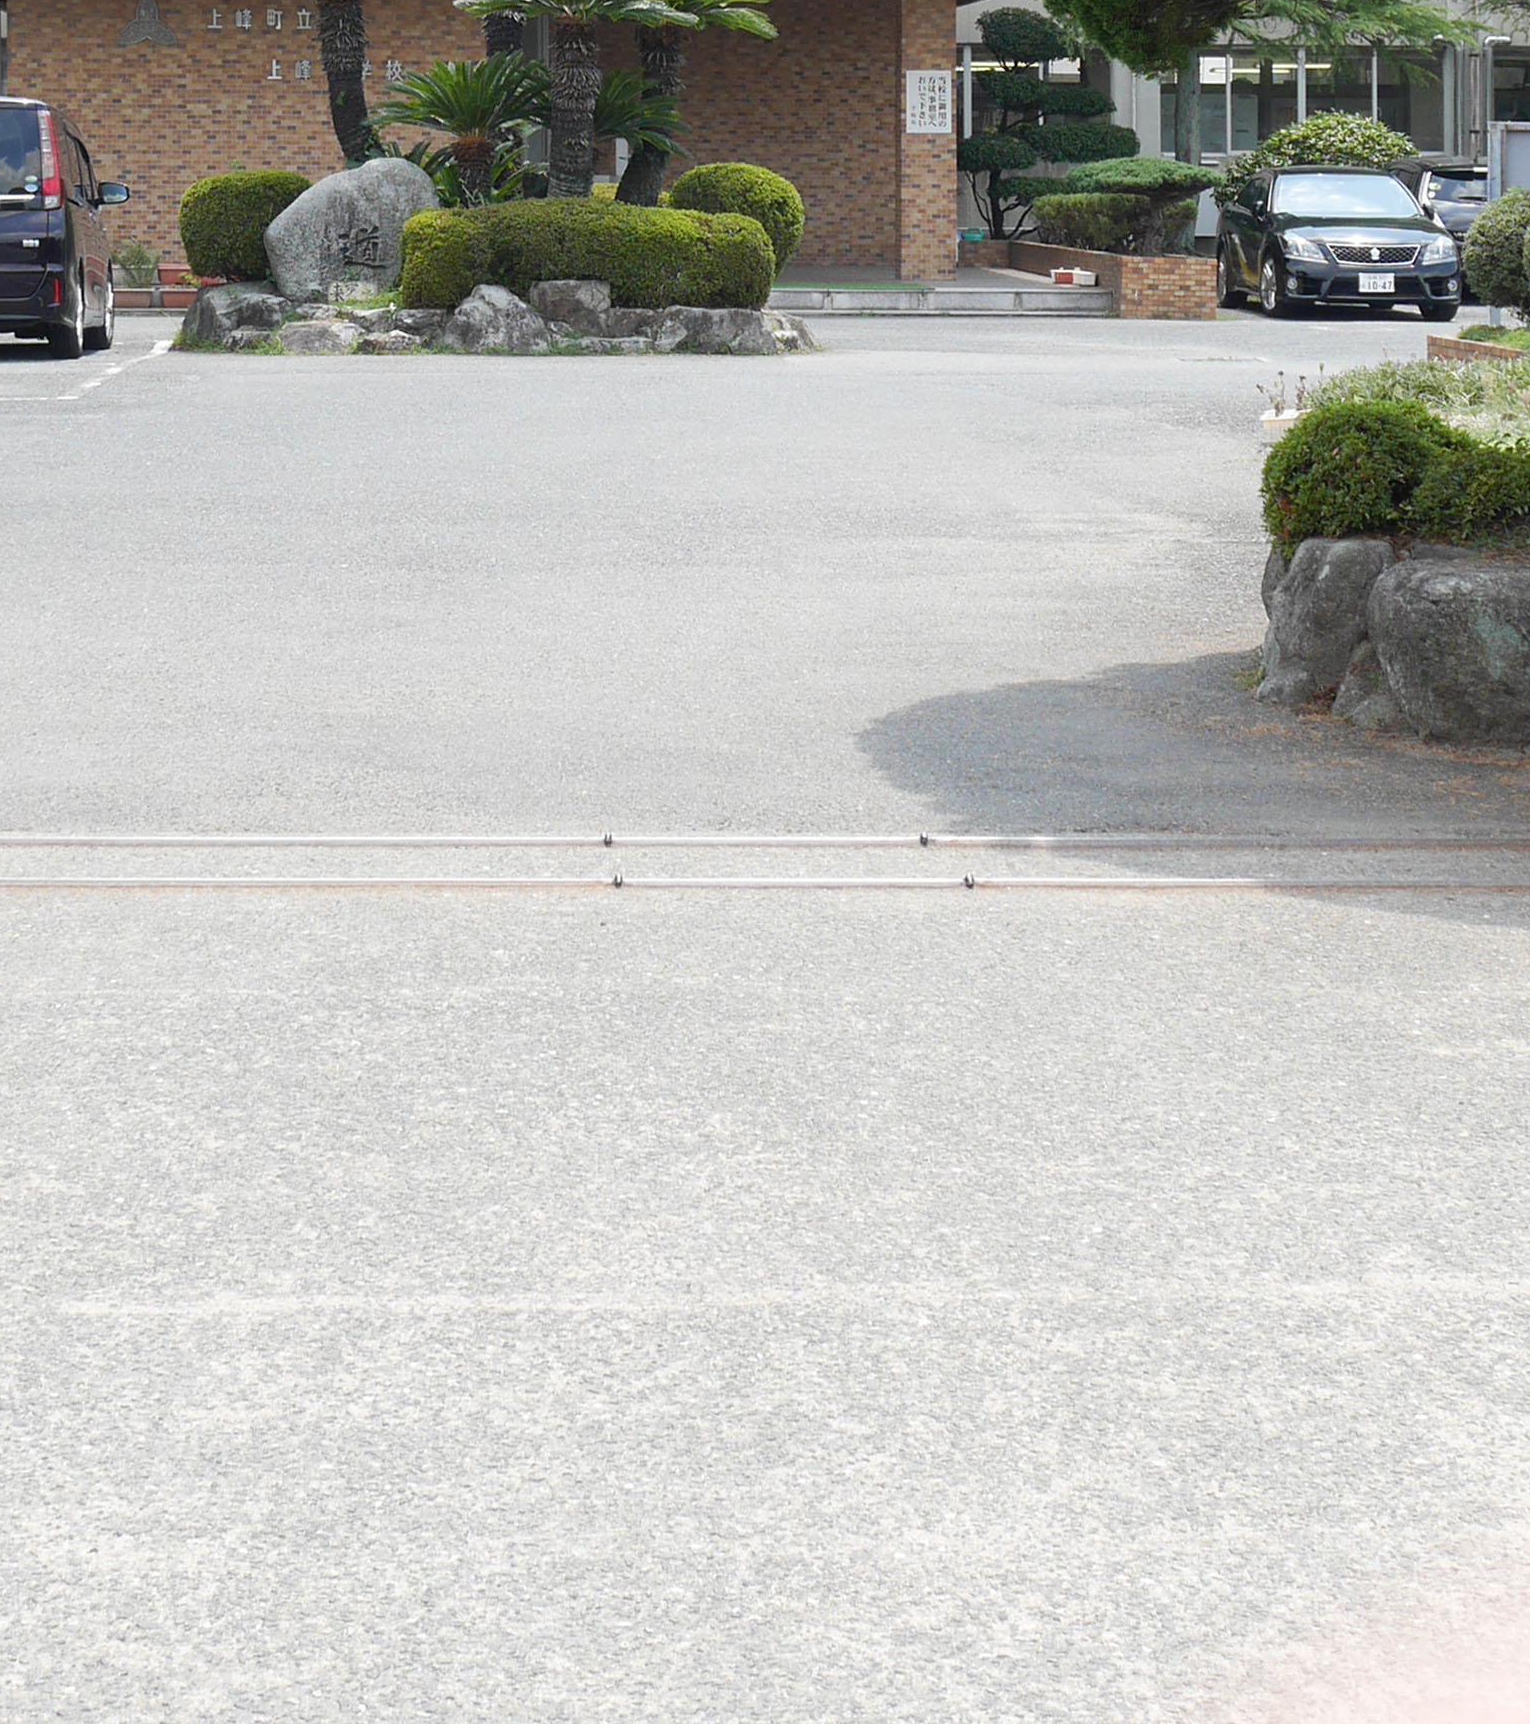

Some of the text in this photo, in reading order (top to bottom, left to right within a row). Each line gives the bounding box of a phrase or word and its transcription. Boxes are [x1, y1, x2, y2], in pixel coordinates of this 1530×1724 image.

[207, 8, 312, 31] 上峰町立
[267, 59, 405, 82] 上峰学校
